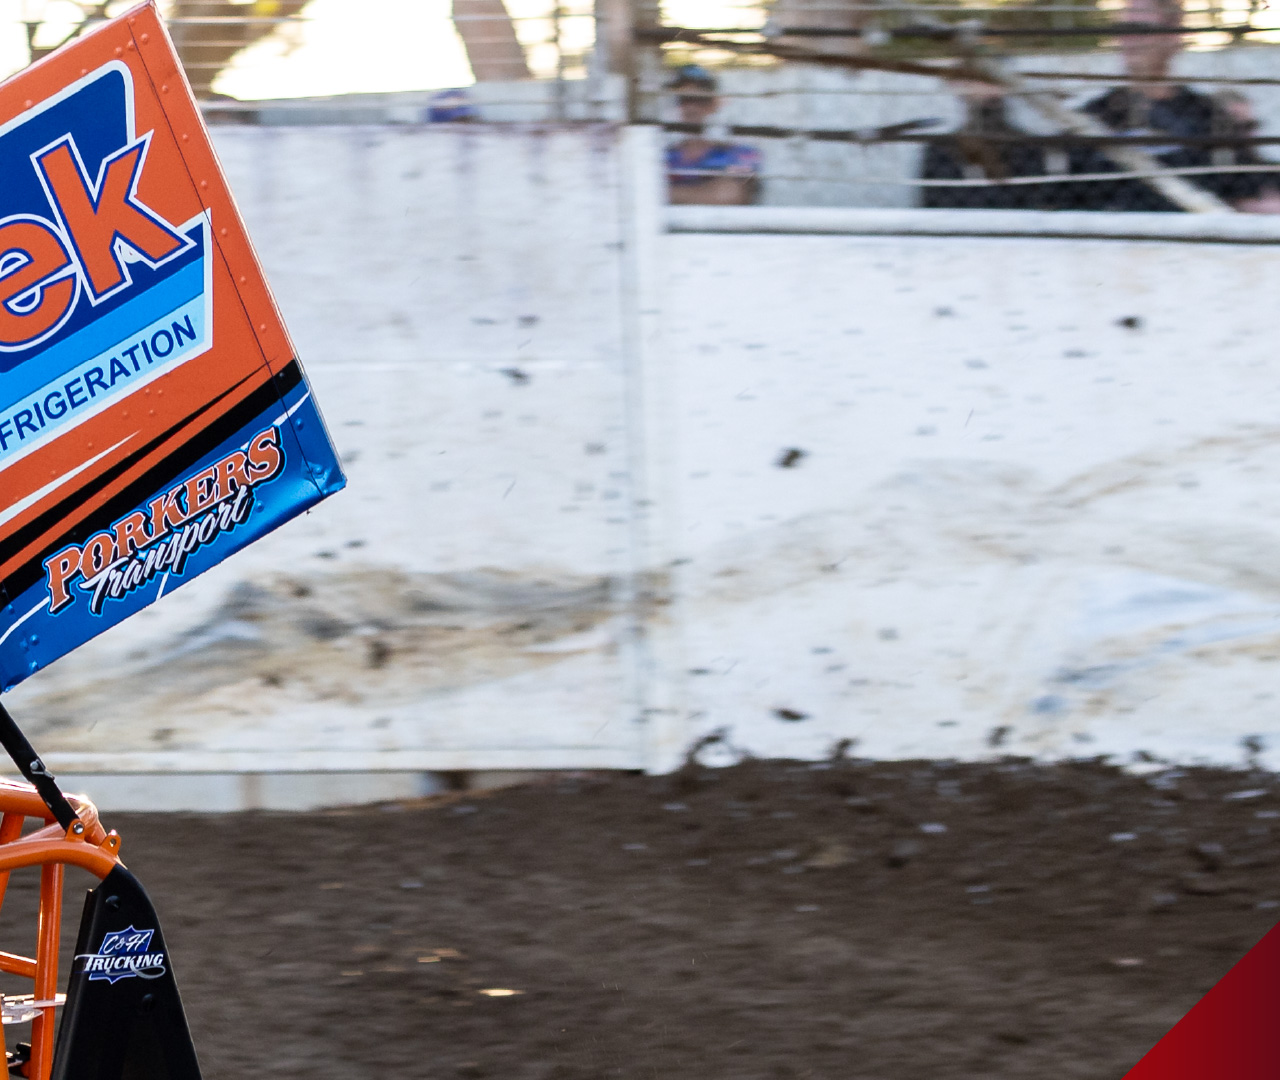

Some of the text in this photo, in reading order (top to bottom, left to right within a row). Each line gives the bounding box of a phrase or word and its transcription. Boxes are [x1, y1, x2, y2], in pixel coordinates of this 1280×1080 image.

[44, 425, 282, 614] PORKERS
[78, 483, 252, 615] Transport
[74, 953, 166, 977] TRUCKING
